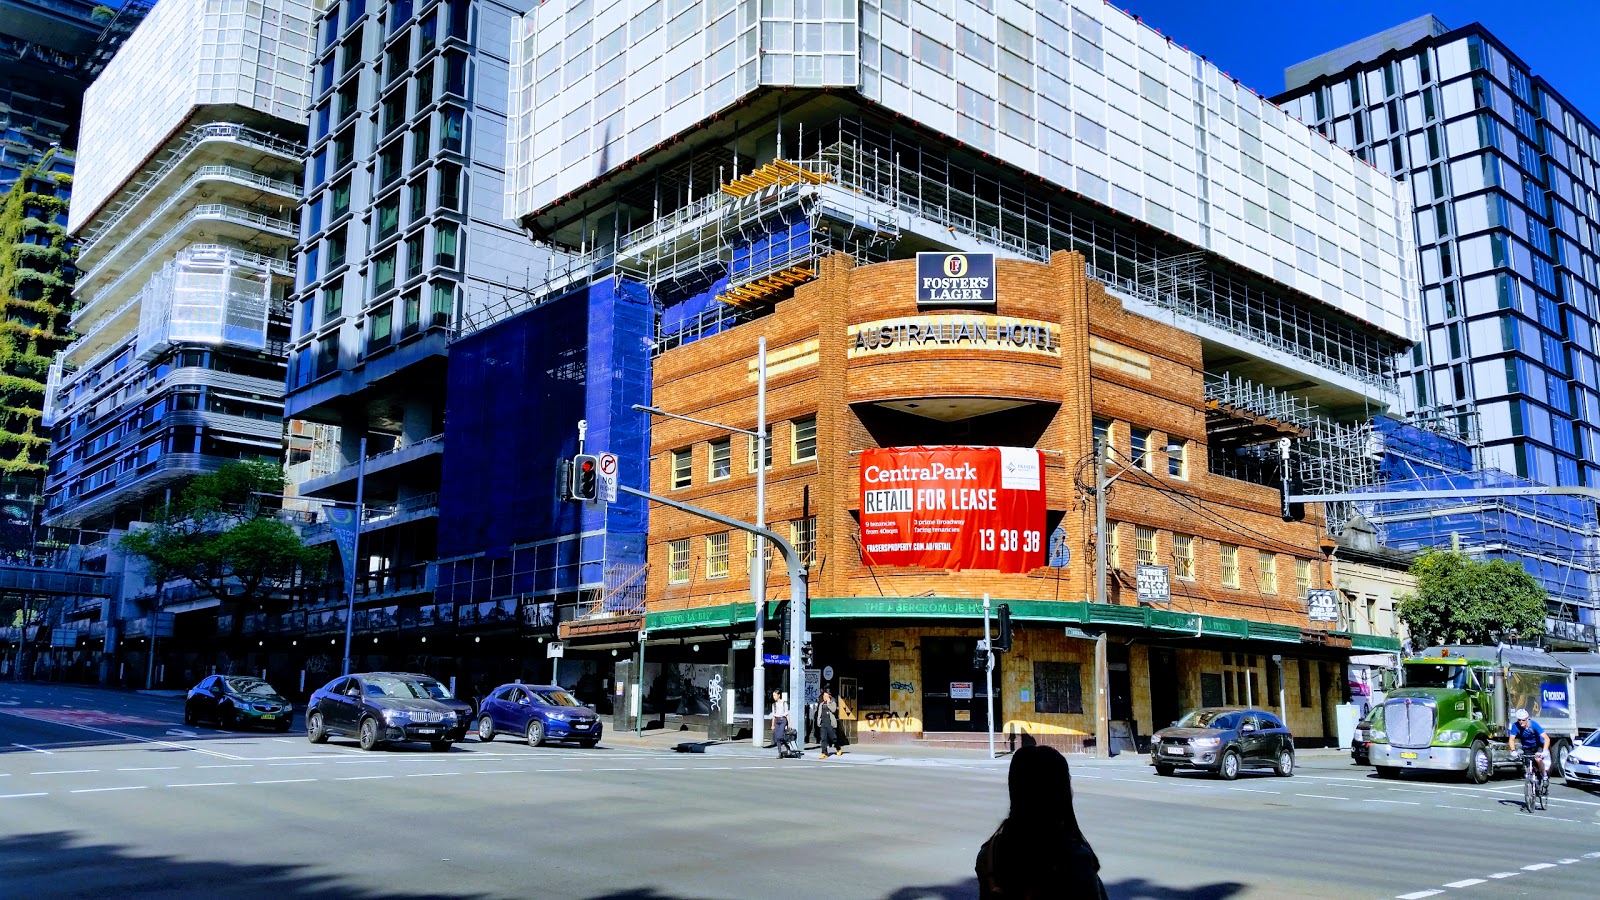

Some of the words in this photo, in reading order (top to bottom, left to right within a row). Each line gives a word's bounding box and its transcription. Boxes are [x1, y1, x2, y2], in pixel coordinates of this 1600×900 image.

[923, 277, 989, 289] FOSTER'S
[930, 288, 982, 300] LAGER
[854, 321, 987, 352] AUSTRALIAN
[996, 323, 1057, 353] HOTEL
[602, 476, 613, 485] NO
[866, 490, 912, 512] RETAIL
[917, 488, 947, 511] FOR
[951, 488, 997, 511] LEASE
[979, 529, 995, 552] 13
[999, 529, 1018, 552] 38
[1022, 530, 1041, 553] 38
[864, 602, 884, 611] THE
[1548, 691, 1566, 701] ROBSON
